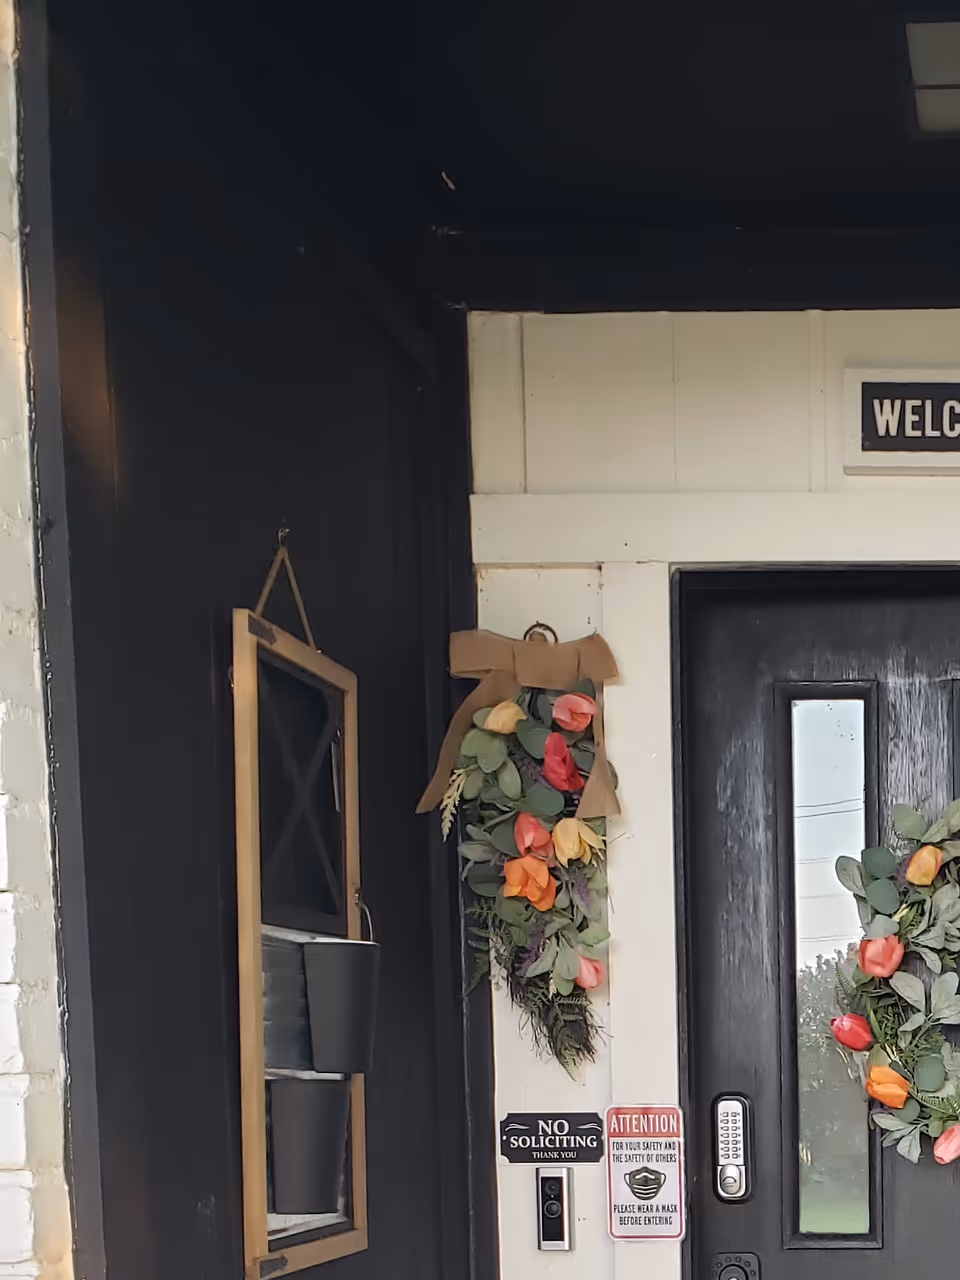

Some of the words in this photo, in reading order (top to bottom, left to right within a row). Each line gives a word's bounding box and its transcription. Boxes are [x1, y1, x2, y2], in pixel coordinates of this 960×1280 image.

[537, 1119, 570, 1136] NO
[610, 1114, 677, 1133] ATTENTION
[510, 1135, 598, 1148] SOLICITING
[612, 1141, 623, 1151] FOR
[625, 1141, 641, 1151] YOUR
[642, 1141, 663, 1151] SAFETY
[664, 1141, 676, 1151] AND
[532, 1151, 559, 1159] THANK
[560, 1151, 577, 1159] YOU
[612, 1153, 623, 1163] THE
[624, 1153, 645, 1163] SAFETY
[646, 1153, 653, 1163] OF
[655, 1153, 677, 1163] OTHERS
[613, 1204, 635, 1213] PLEASE
[637, 1204, 653, 1213] WEAR
[655, 1204, 660, 1213] A
[661, 1204, 678, 1213] MASK
[619, 1216, 642, 1226] BEFORE
[643, 1216, 673, 1226] ENTERING
